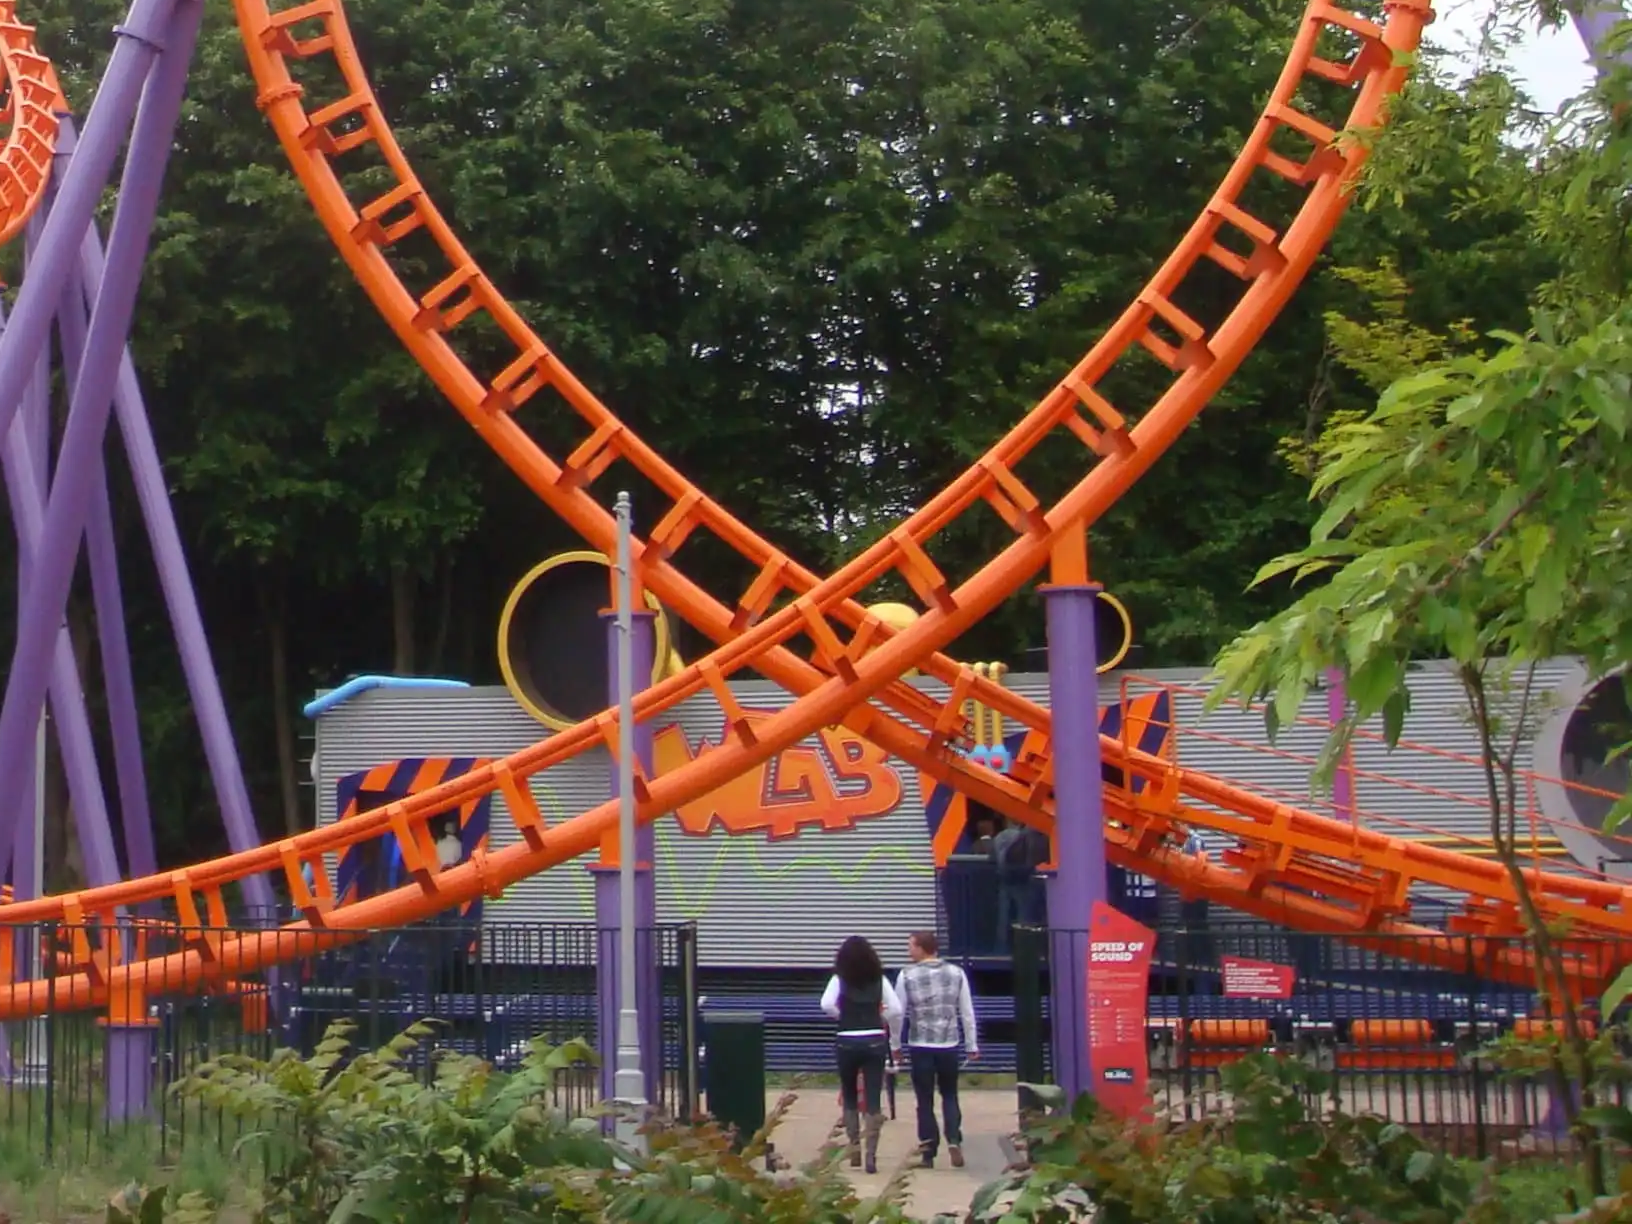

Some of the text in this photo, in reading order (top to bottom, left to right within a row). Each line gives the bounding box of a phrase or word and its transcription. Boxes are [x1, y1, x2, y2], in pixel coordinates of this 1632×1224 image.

[1090, 942, 1144, 952] SPEED OF
[1091, 952, 1133, 962] SOUND
